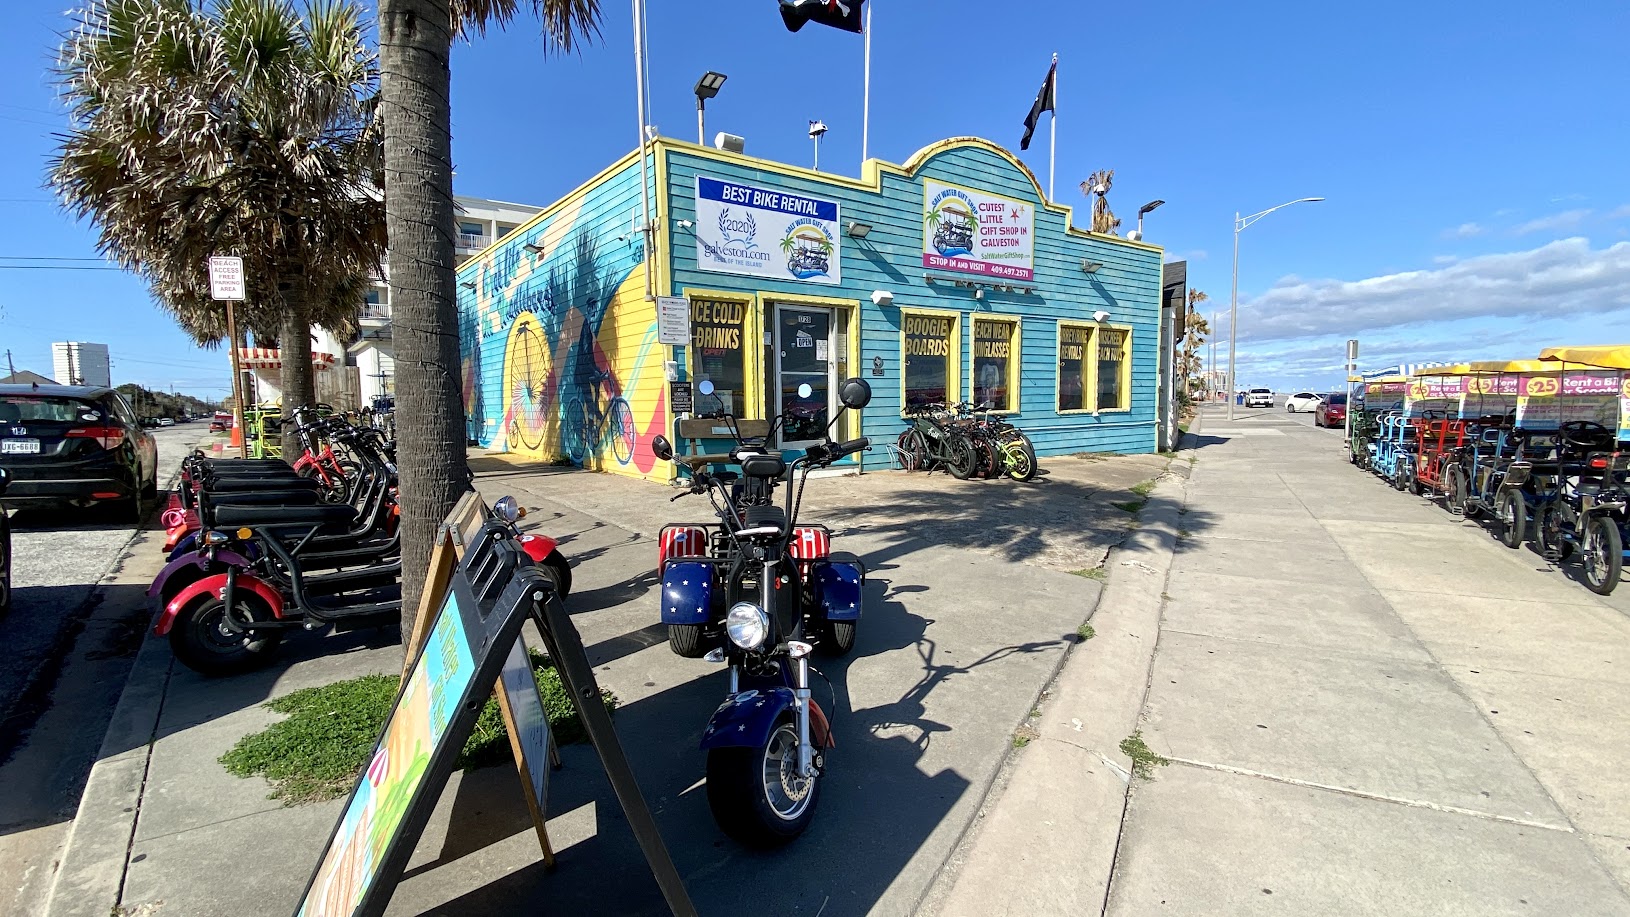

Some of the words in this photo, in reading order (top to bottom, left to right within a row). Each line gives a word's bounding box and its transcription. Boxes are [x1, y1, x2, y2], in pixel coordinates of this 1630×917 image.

[722, 185, 752, 203] BEST
[753, 191, 779, 208] BIKE
[780, 196, 819, 215] RENTAL
[931, 193, 942, 206] SALT
[941, 189, 957, 198] WATER
[957, 191, 968, 201] GIFT
[967, 199, 978, 215] SHOP
[978, 203, 1005, 212] CUTEST
[726, 219, 749, 234] 2020
[979, 215, 1003, 224] LITTLE
[785, 222, 796, 235] SALT
[795, 218, 811, 226] WATER
[812, 219, 823, 228] GIFT
[822, 226, 833, 240] SHOP
[980, 226, 997, 235] GIFT
[999, 226, 1019, 235] SHOP
[1020, 227, 1027, 235] IN
[704, 241, 770, 261] galveston.com
[980, 238, 1020, 247] GALVESTON
[929, 256, 948, 266] STOP
[949, 259, 956, 267] IN
[957, 261, 968, 269] AND
[969, 262, 985, 271] VISIT!
[990, 265, 1029, 277] 409.497.2571
[691, 300, 711, 322] ICE
[712, 302, 742, 325] COLD
[905, 317, 948, 336] BOOGIE
[992, 323, 1010, 340] WEAR
[696, 326, 740, 350] DRINKS
[798, 338, 812, 347] OPEN
[905, 337, 949, 356] BOARDS
[974, 341, 1010, 358] UNGLASSES
[1528, 379, 1556, 393] $25
[1563, 378, 1593, 386] Rent
[1575, 386, 1618, 394] Scoote
[775, 577, 781, 590] 3
